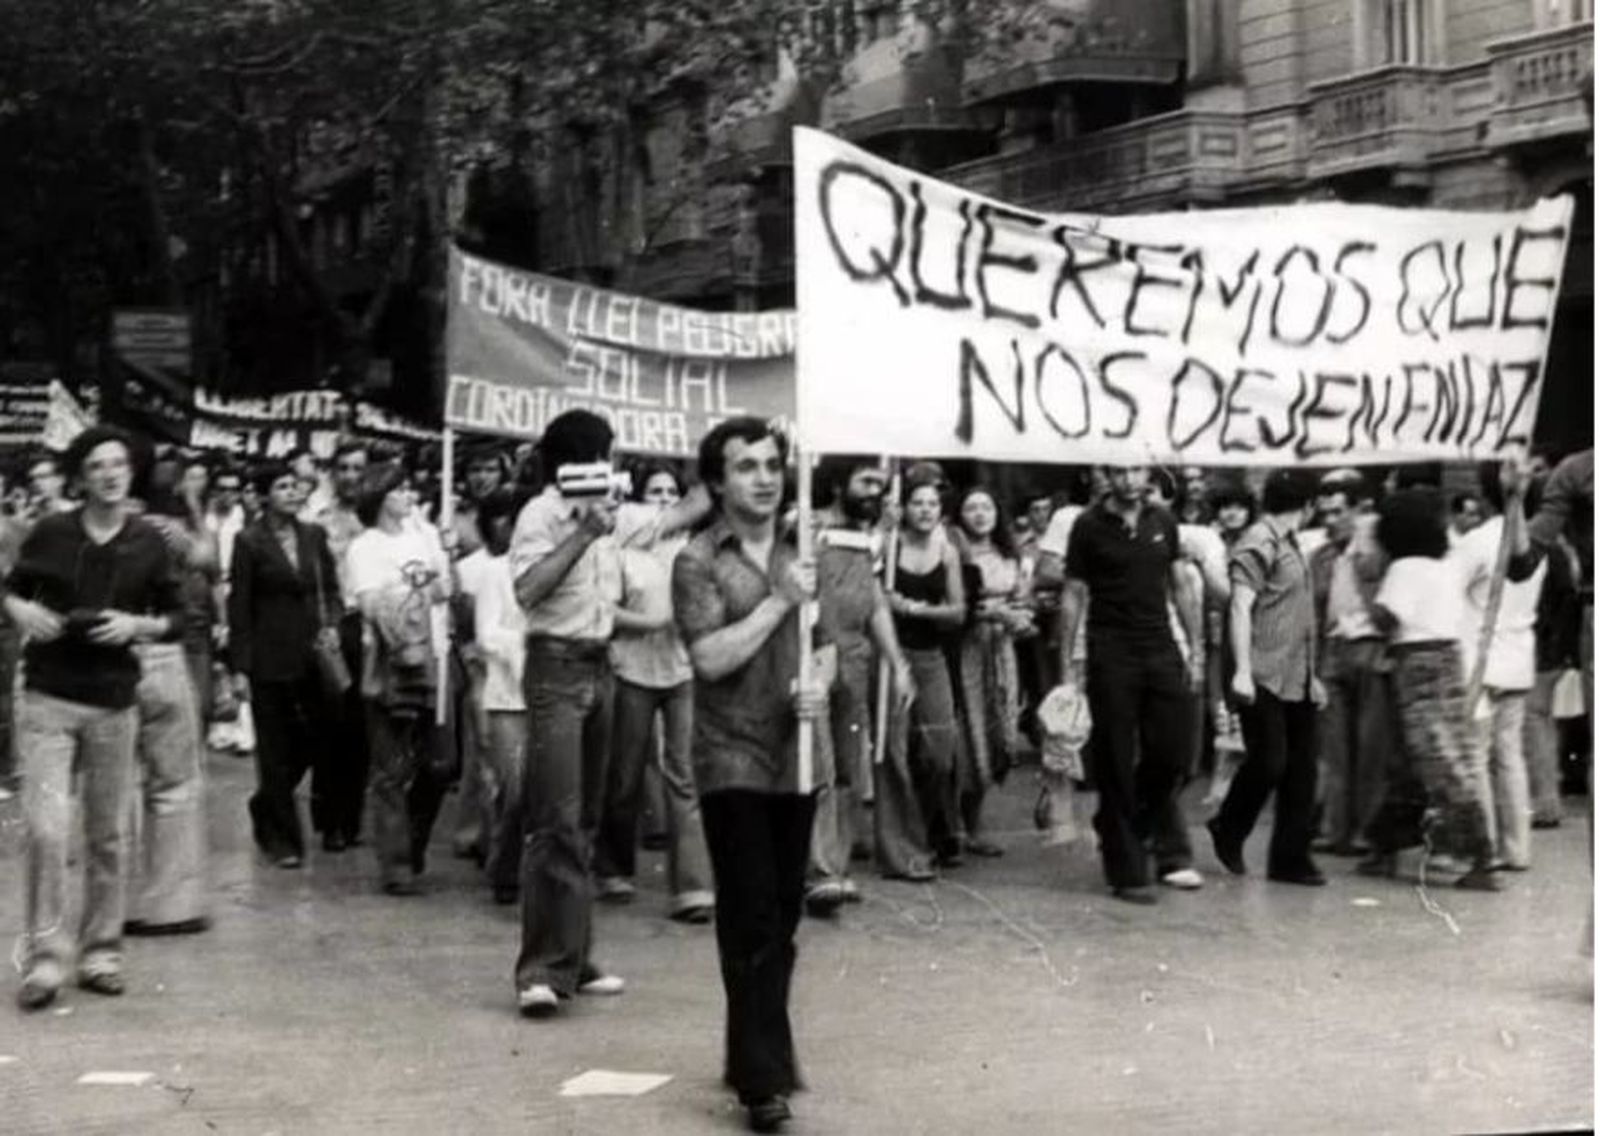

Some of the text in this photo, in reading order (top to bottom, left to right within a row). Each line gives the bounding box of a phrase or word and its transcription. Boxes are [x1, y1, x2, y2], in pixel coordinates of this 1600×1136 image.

[460, 255, 552, 329] FORA
[567, 286, 641, 347] LLEI
[819, 160, 1565, 357] QUEREMOS QUE
[955, 337, 1147, 446] NOS
[1167, 358, 1391, 460] DEJEN
